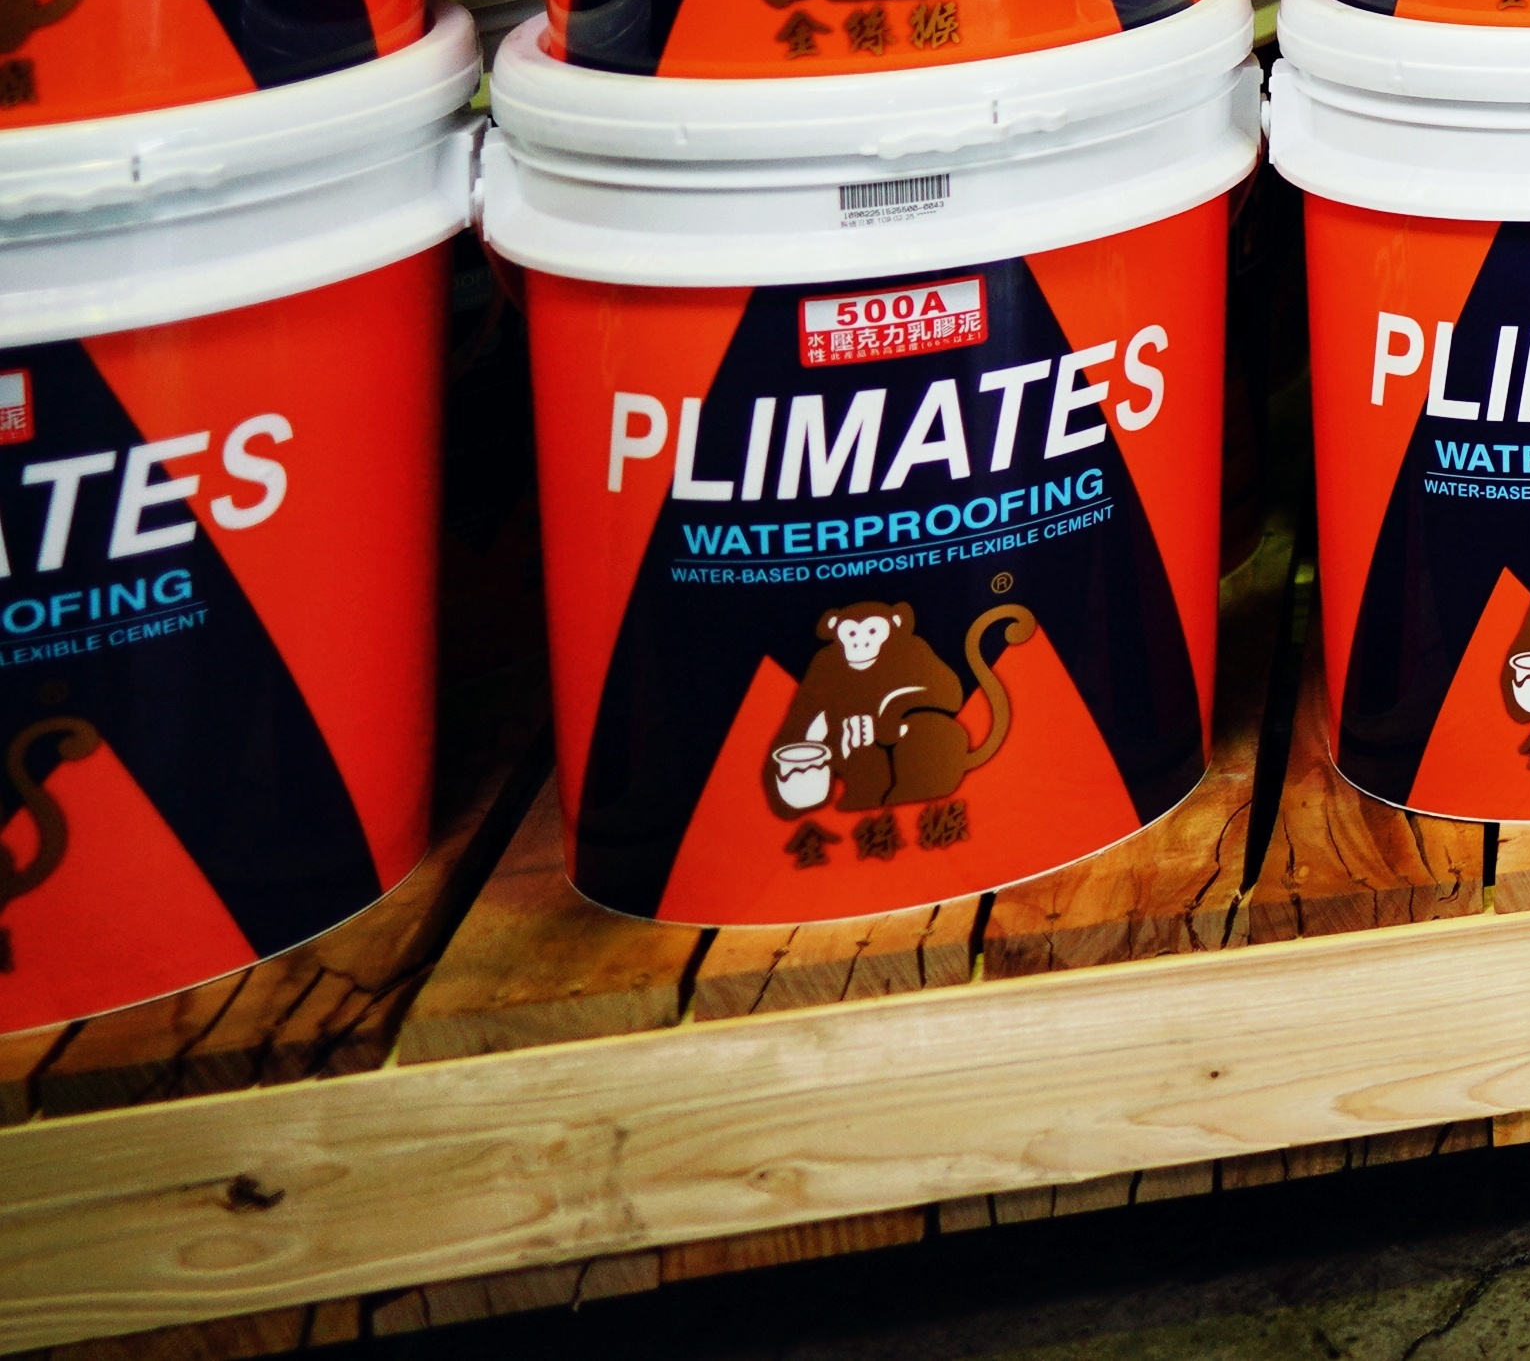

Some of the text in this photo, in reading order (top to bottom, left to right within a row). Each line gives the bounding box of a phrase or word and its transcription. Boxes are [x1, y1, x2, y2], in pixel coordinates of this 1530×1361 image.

[835, 295, 949, 327] 500A
[607, 324, 1169, 502] PLIMATES
[0, 413, 294, 578] TES
[682, 467, 1104, 557] WATERPROOFING
[0, 609, 208, 666] LEXIBLE CEMENT
